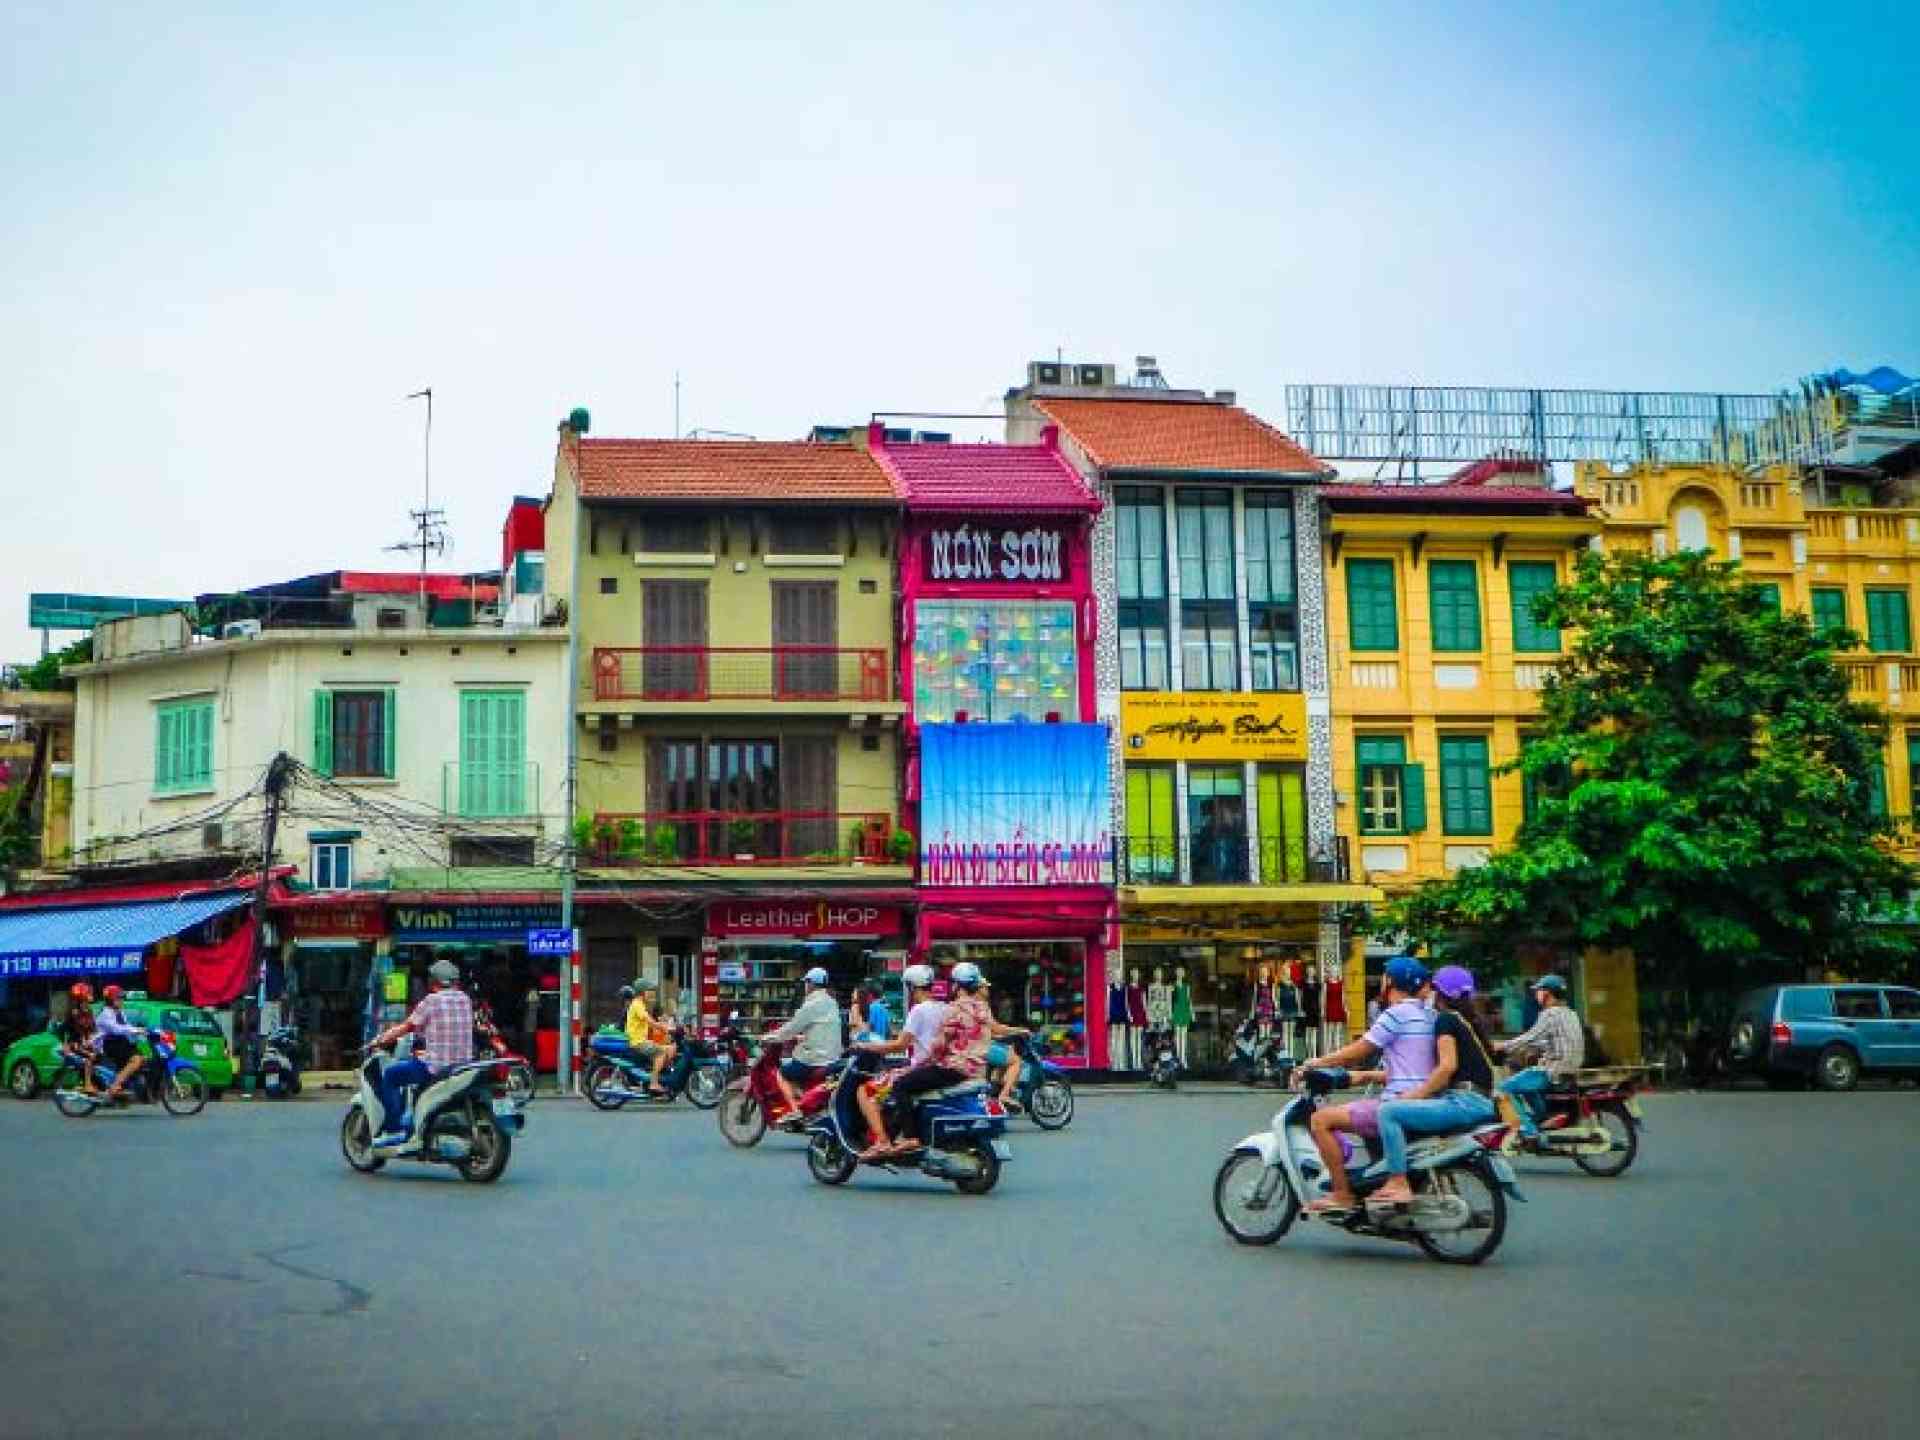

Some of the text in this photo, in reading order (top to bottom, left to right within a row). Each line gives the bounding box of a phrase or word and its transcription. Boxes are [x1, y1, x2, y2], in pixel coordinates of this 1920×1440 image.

[931, 523, 992, 579] NÓN
[398, 908, 453, 929] Vinh
[727, 907, 811, 928] Leather
